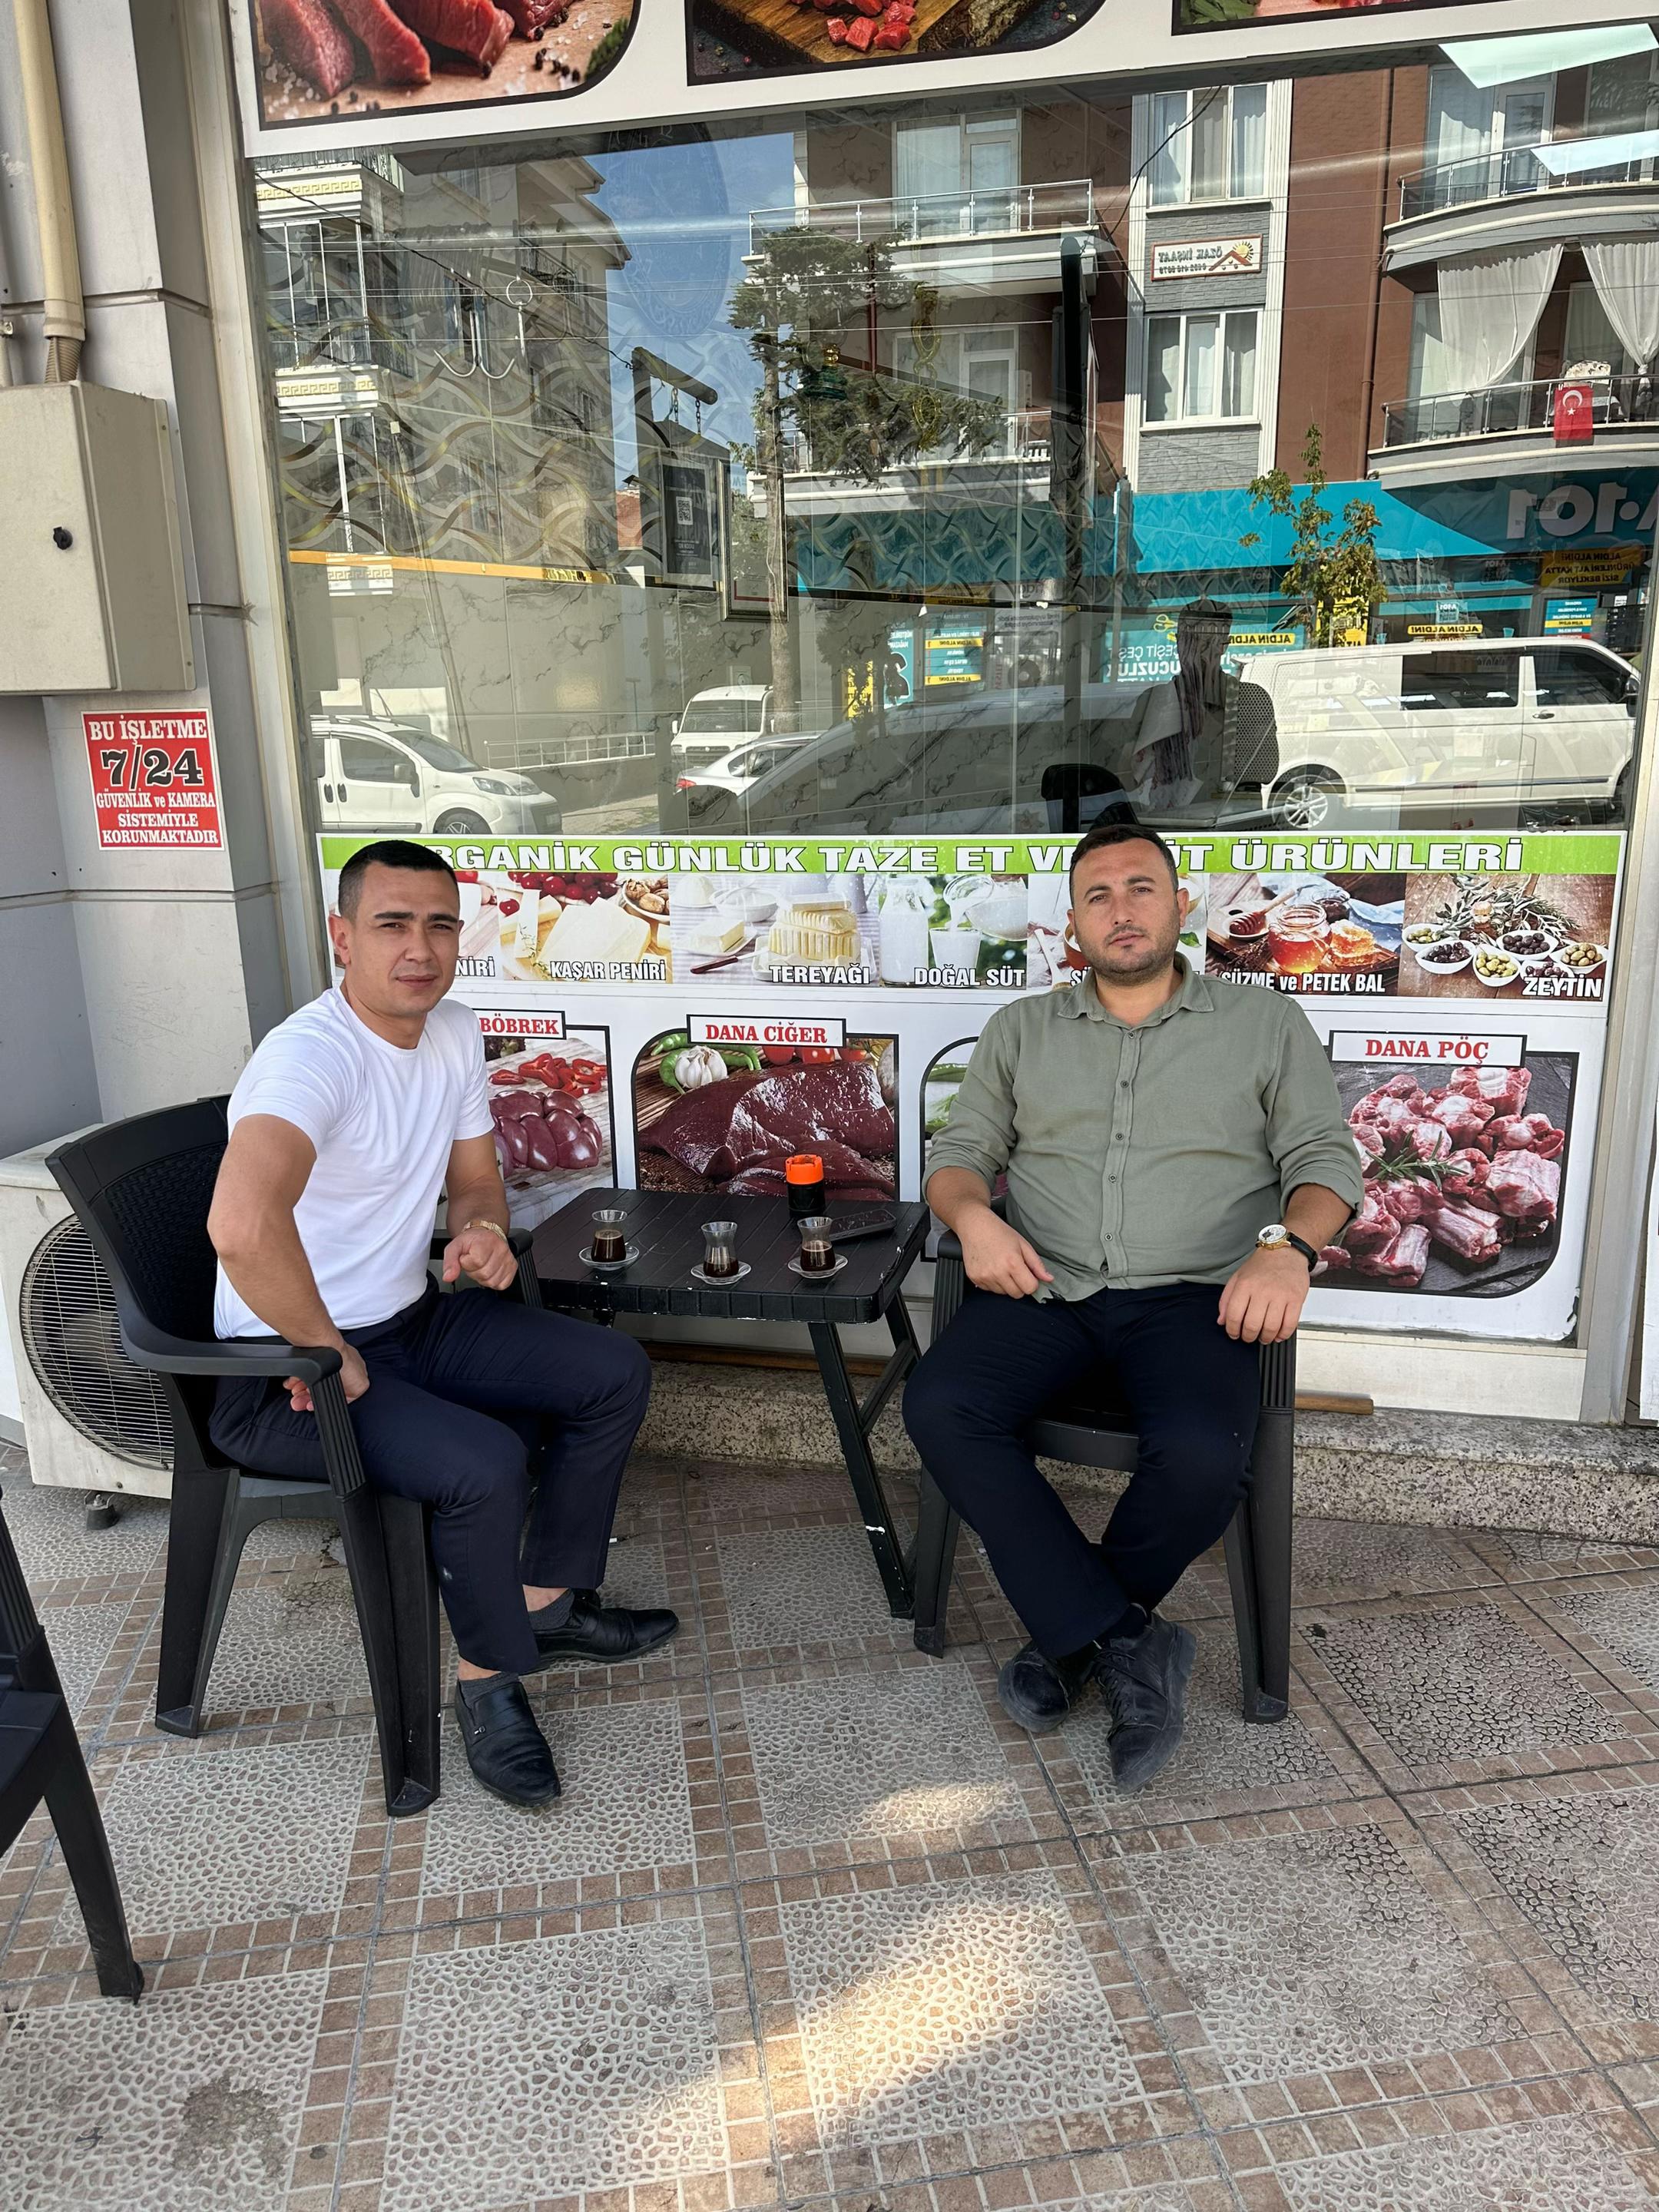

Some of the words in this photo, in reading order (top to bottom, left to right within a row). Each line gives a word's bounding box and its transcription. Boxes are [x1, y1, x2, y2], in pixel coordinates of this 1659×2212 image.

[88, 720, 115, 741] BU
[119, 714, 207, 745] İŞLETME
[100, 745, 205, 791] 7/24
[96, 788, 153, 809] GÜVENLİK
[154, 796, 166, 808] ve
[167, 792, 216, 808] KAMERA
[118, 810, 199, 827] SİSTEMİYLE
[101, 830, 219, 843] KORUNMAKTADIR
[426, 841, 601, 872] RGANİK
[612, 841, 807, 873] GÜNLÜK
[818, 846, 939, 873] TAZE
[955, 846, 1014, 873] ET
[1230, 837, 1523, 872] ÜRÜNLERİ
[549, 961, 606, 982] KAŞAR
[608, 959, 667, 981] PENİRİ
[769, 963, 870, 985] TEREYAĞI
[914, 964, 982, 988] DOĞAL
[985, 965, 1025, 987] SÜT
[1220, 969, 1276, 991] SÜZME
[1279, 974, 1298, 992] ve
[1301, 972, 1349, 993] PETEK
[1354, 974, 1386, 993] BAL
[1522, 974, 1603, 998] ZEYTİN
[479, 1013, 559, 1035] BÖBREK
[705, 1024, 760, 1041] DANA
[763, 1021, 828, 1044] CİĞER
[1365, 1039, 1431, 1058] DANA
[1437, 1035, 1489, 1065] PÖÇ
